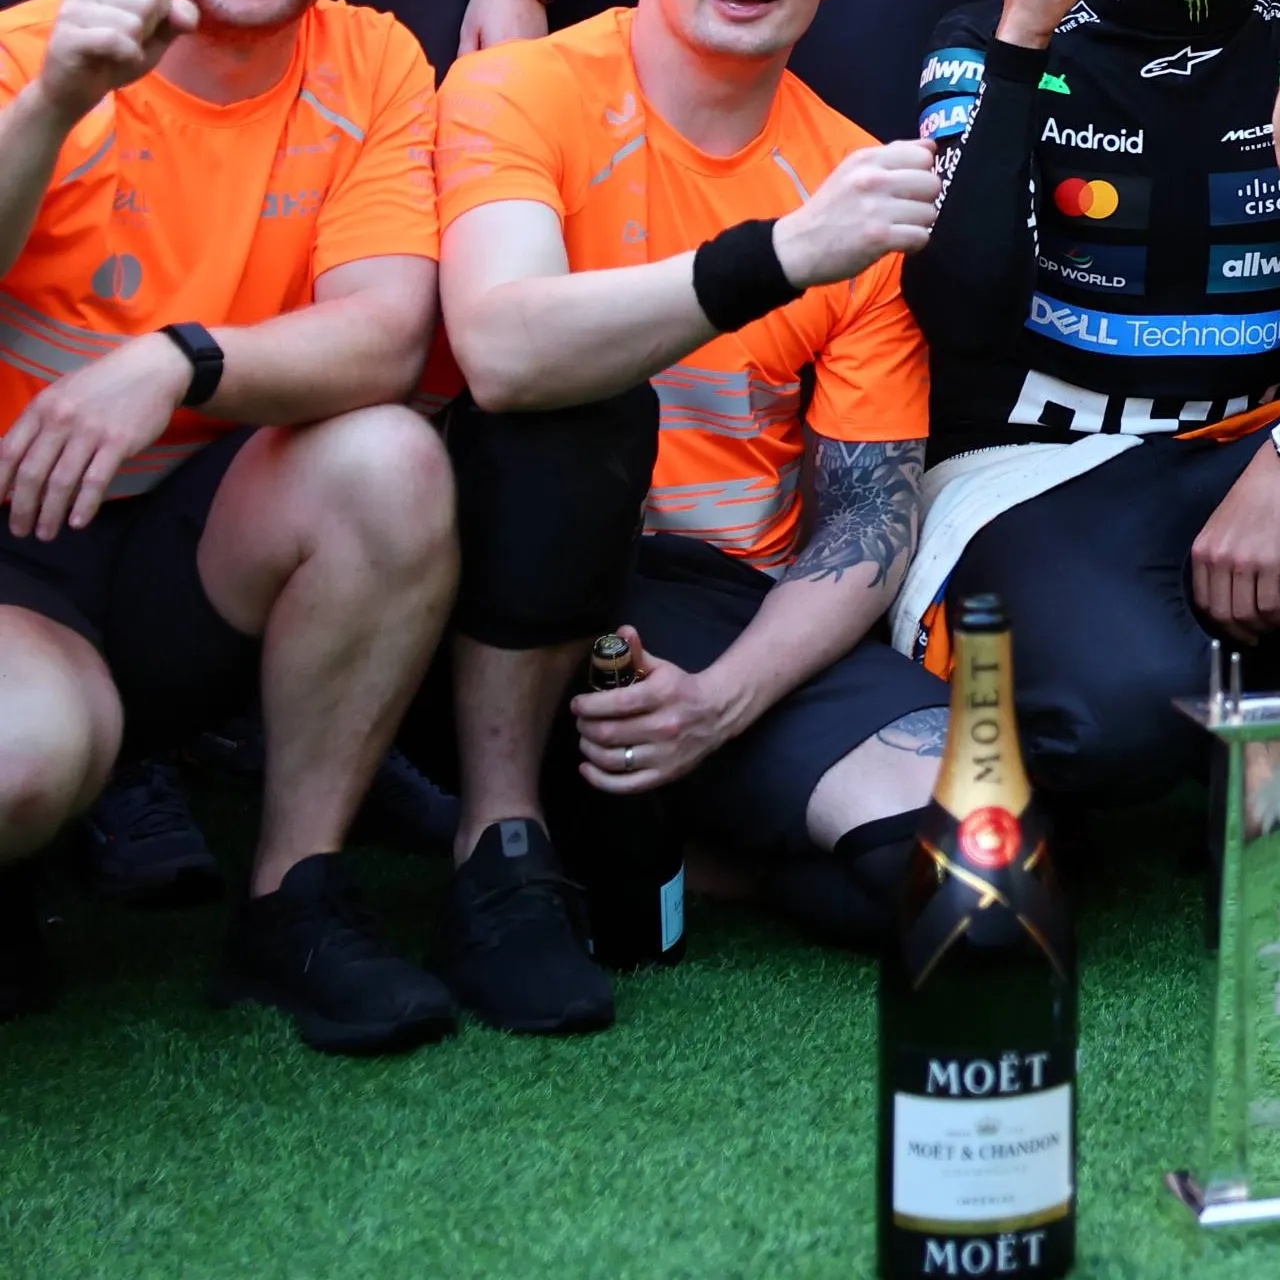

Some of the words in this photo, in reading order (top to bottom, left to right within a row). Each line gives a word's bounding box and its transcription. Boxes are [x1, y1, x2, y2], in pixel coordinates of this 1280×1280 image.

[1041, 117, 1143, 155] Android
[1039, 256, 1059, 273] DP
[1060, 263, 1126, 288] WORLD
[1032, 295, 1118, 347] DELL
[971, 656, 1002, 785] MOËT
[927, 1050, 1048, 1095] MOËT
[908, 1140, 957, 1161] MOËT
[960, 1147, 973, 1161] &
[978, 1133, 1061, 1161] CHANDON
[924, 1231, 1046, 1275] MOËT
